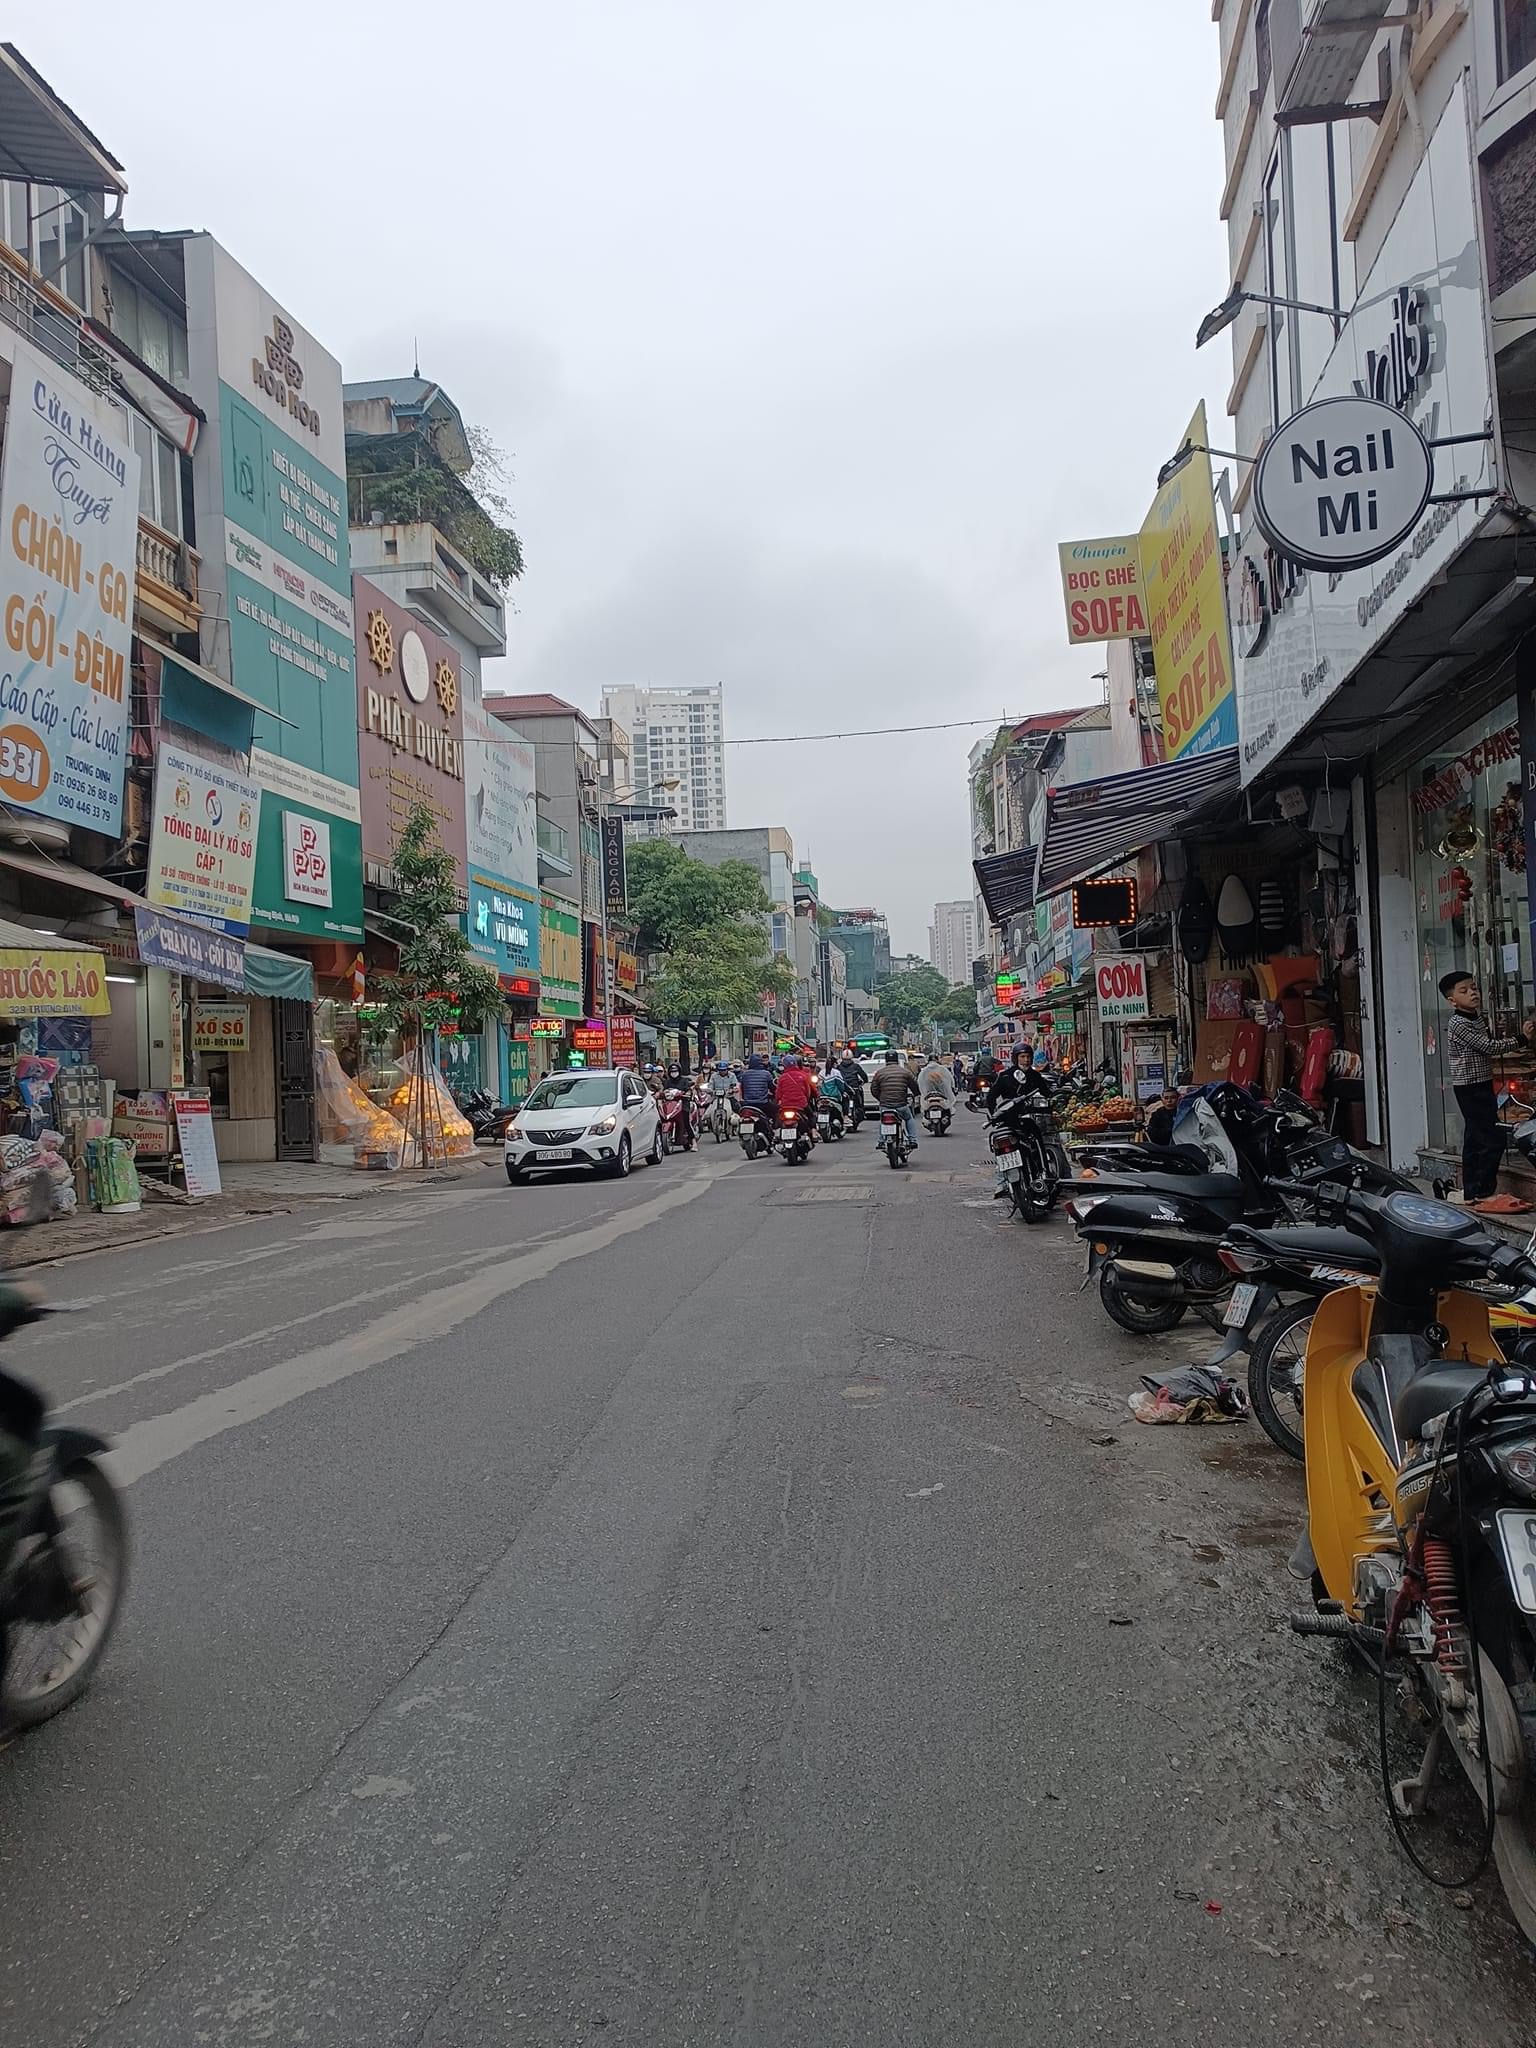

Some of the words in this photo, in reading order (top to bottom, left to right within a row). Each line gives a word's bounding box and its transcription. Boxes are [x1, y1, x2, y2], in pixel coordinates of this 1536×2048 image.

[34, 379, 72, 435] Cửa
[80, 417, 126, 487] Hàng
[1290, 428, 1394, 484] Nail
[44, 435, 113, 525] Tuyết
[1317, 489, 1378, 537] Mi
[12, 503, 82, 594] CHĂN
[99, 562, 128, 624] GA
[1071, 544, 1127, 560] Chuyên
[1067, 570, 1101, 593] BỌC
[1105, 560, 1137, 586] GHẾ
[1070, 594, 1146, 638] SOFA
[5, 589, 55, 668] GỐI
[74, 630, 124, 705] ĐỆM
[1164, 631, 1227, 748] SOFA
[0, 673, 28, 716] Cao
[31, 687, 59, 736] Cấp
[71, 705, 92, 744] Các
[95, 716, 121, 761] Loại
[364, 688, 411, 756] PHẬT
[413, 714, 464, 782] DUYÊN
[0, 735, 42, 789] 331
[186, 762, 194, 775] TY
[66, 777, 86, 794] 0926
[87, 783, 96, 797] 26
[108, 791, 118, 805] 89
[58, 794, 74, 809] 090
[75, 798, 91, 815] 446
[92, 804, 100, 819] 33
[101, 808, 111, 822] 79
[163, 812, 192, 840] TỔNG
[194, 826, 211, 848] ĐẠI
[213, 830, 226, 849] LÝ
[226, 832, 239, 855] XỔ
[240, 837, 253, 858] SỐ
[196, 849, 216, 871] CẤP
[218, 859, 224, 875] 1
[493, 895, 507, 915] Nha
[506, 897, 524, 920] Khoa
[159, 925, 189, 957] CHĂN
[189, 937, 203, 961] GA
[208, 937, 224, 968] GỐI
[61, 961, 99, 998] LÀO
[1098, 962, 1145, 1000] CƠM
[9, 1005, 26, 1014] 329
[196, 1016, 217, 1034] XỔ
[222, 1016, 244, 1035] SỐ
[547, 1020, 562, 1030] TÓC
[611, 1018, 619, 1029] IN
[1122, 1002, 1146, 1016] NINH
[510, 1045, 527, 1070] CẮT
[511, 1074, 528, 1097] TÓC
[1150, 1214, 1185, 1223] HONDA
[1310, 1263, 1376, 1285] Wave
